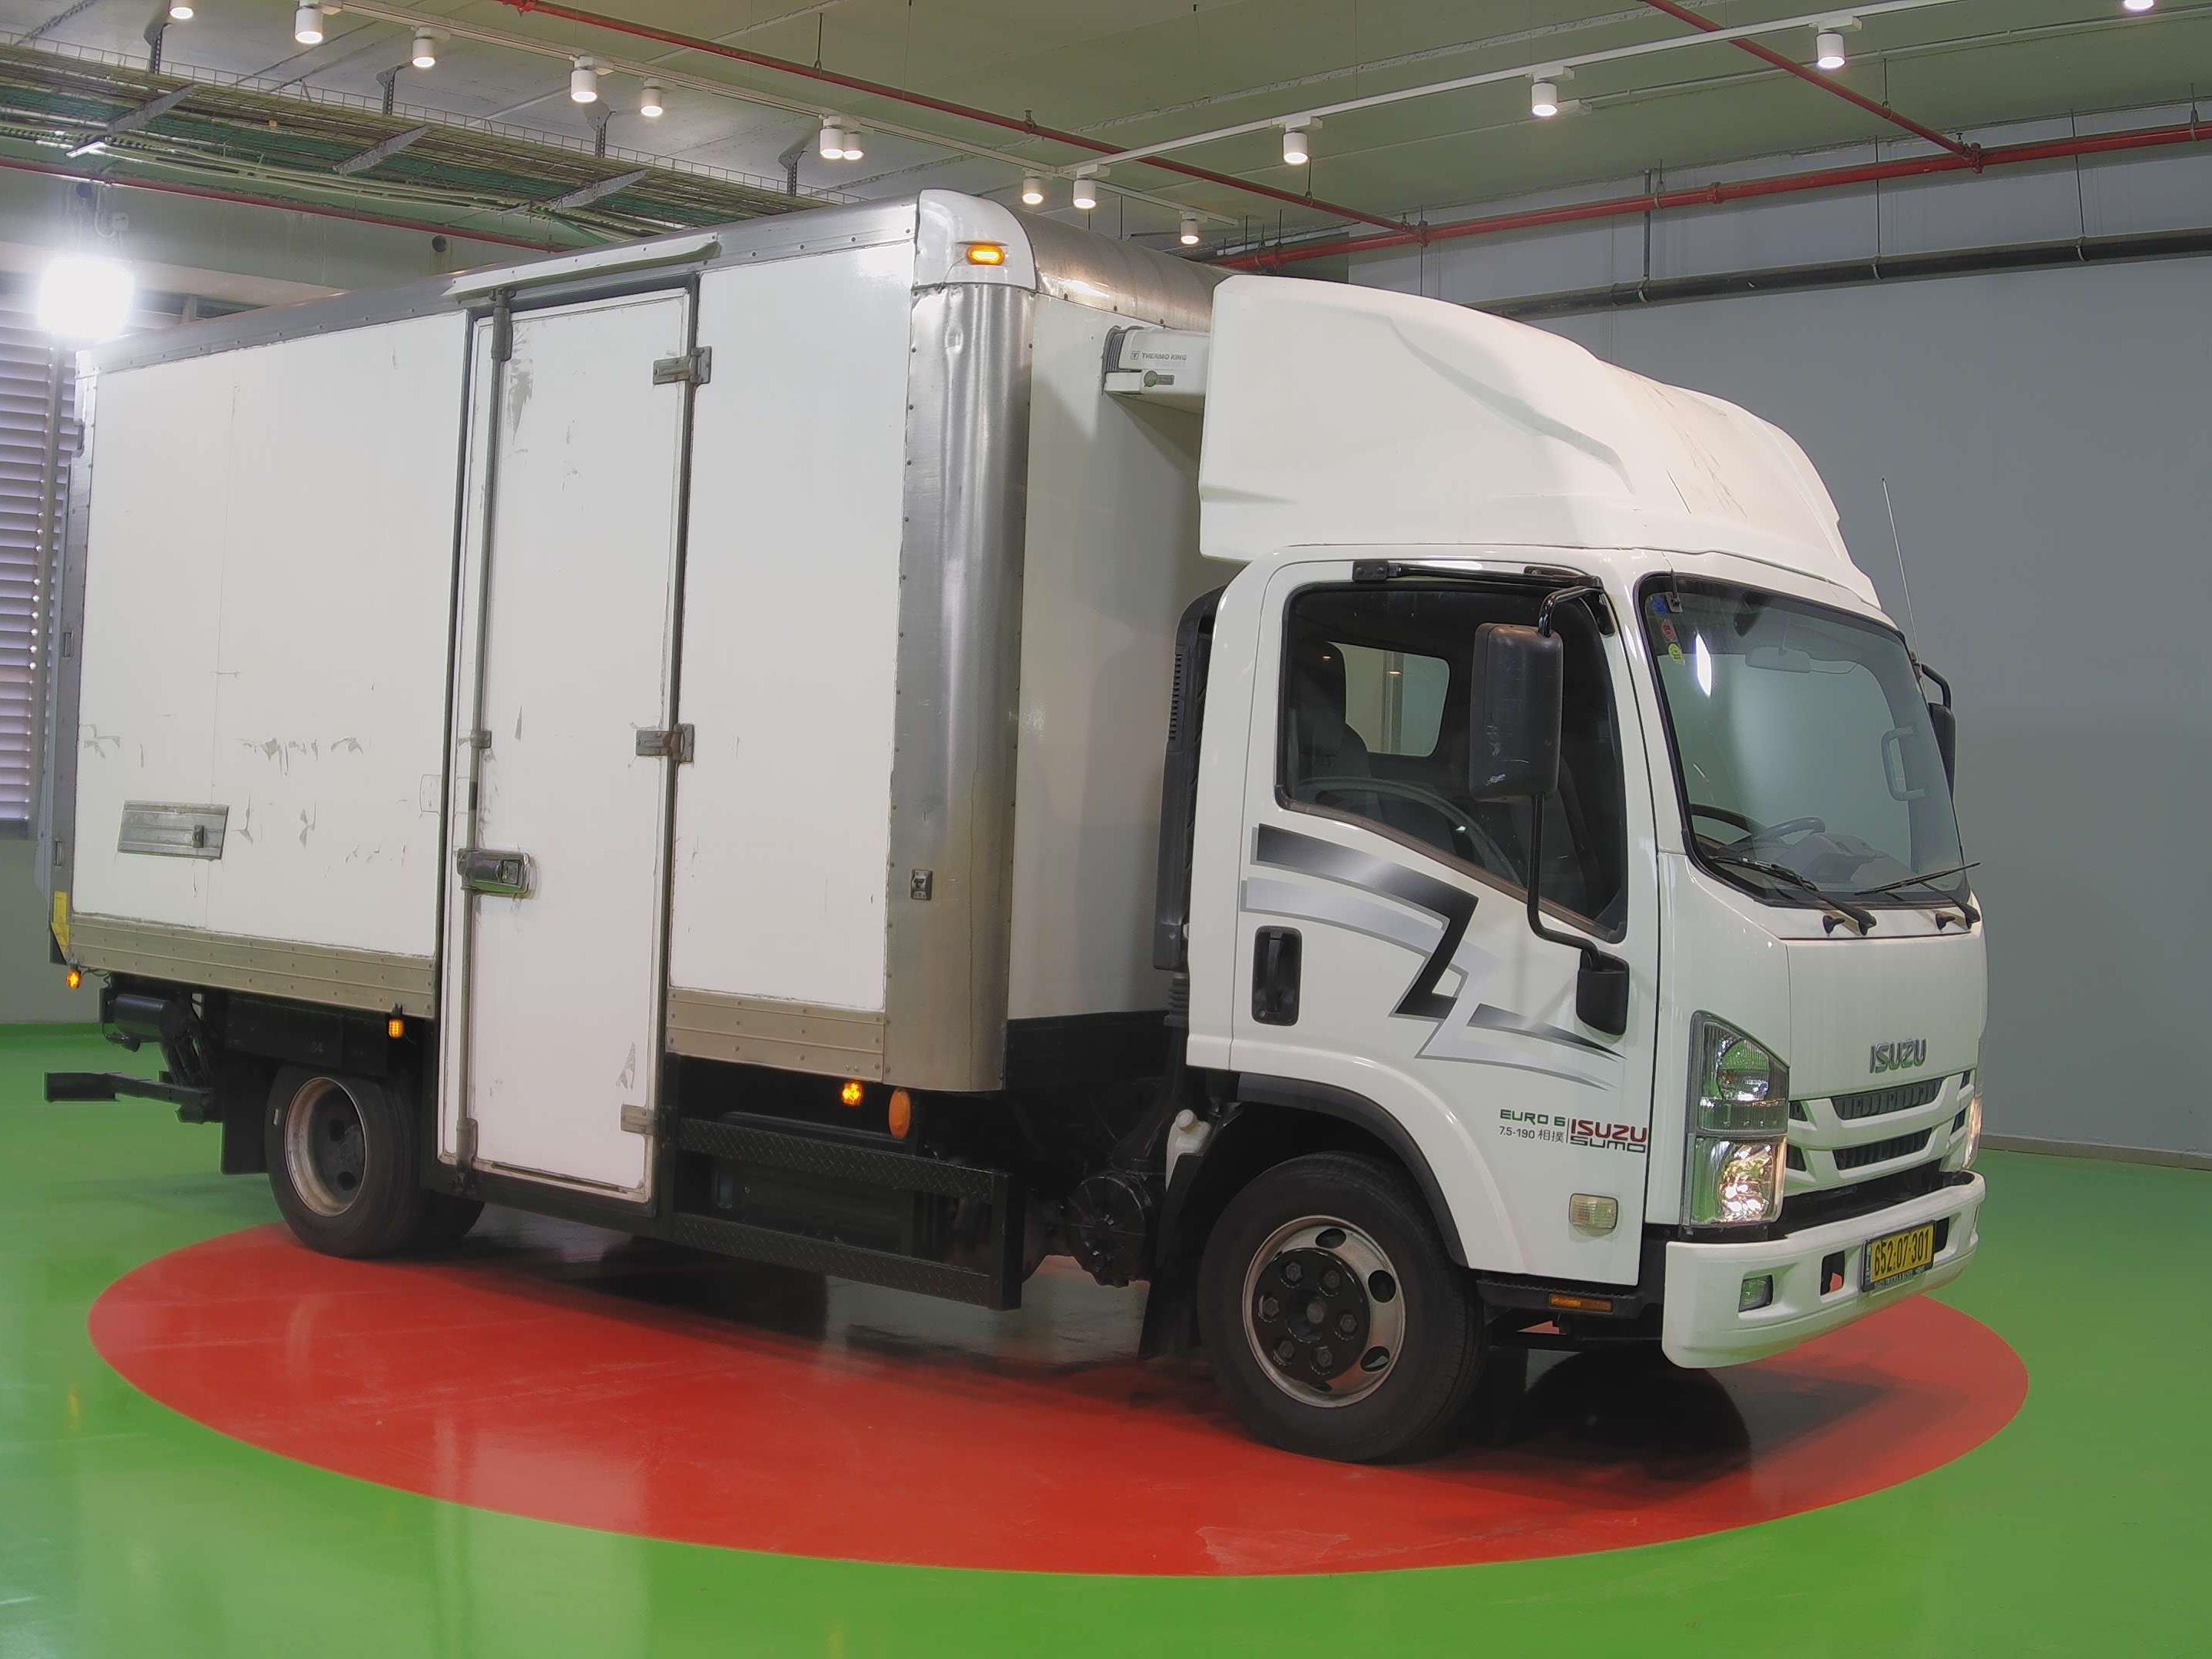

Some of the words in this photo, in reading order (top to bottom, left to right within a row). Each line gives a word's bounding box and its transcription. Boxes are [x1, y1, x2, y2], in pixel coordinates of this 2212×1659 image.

[1869, 1038, 1927, 1074] ISUZU
[1500, 1108, 1549, 1125] EURO
[1554, 1116, 1566, 1127] 6
[1571, 1118, 1647, 1143] ISUZU
[1570, 1134, 1647, 1154] SUMO
